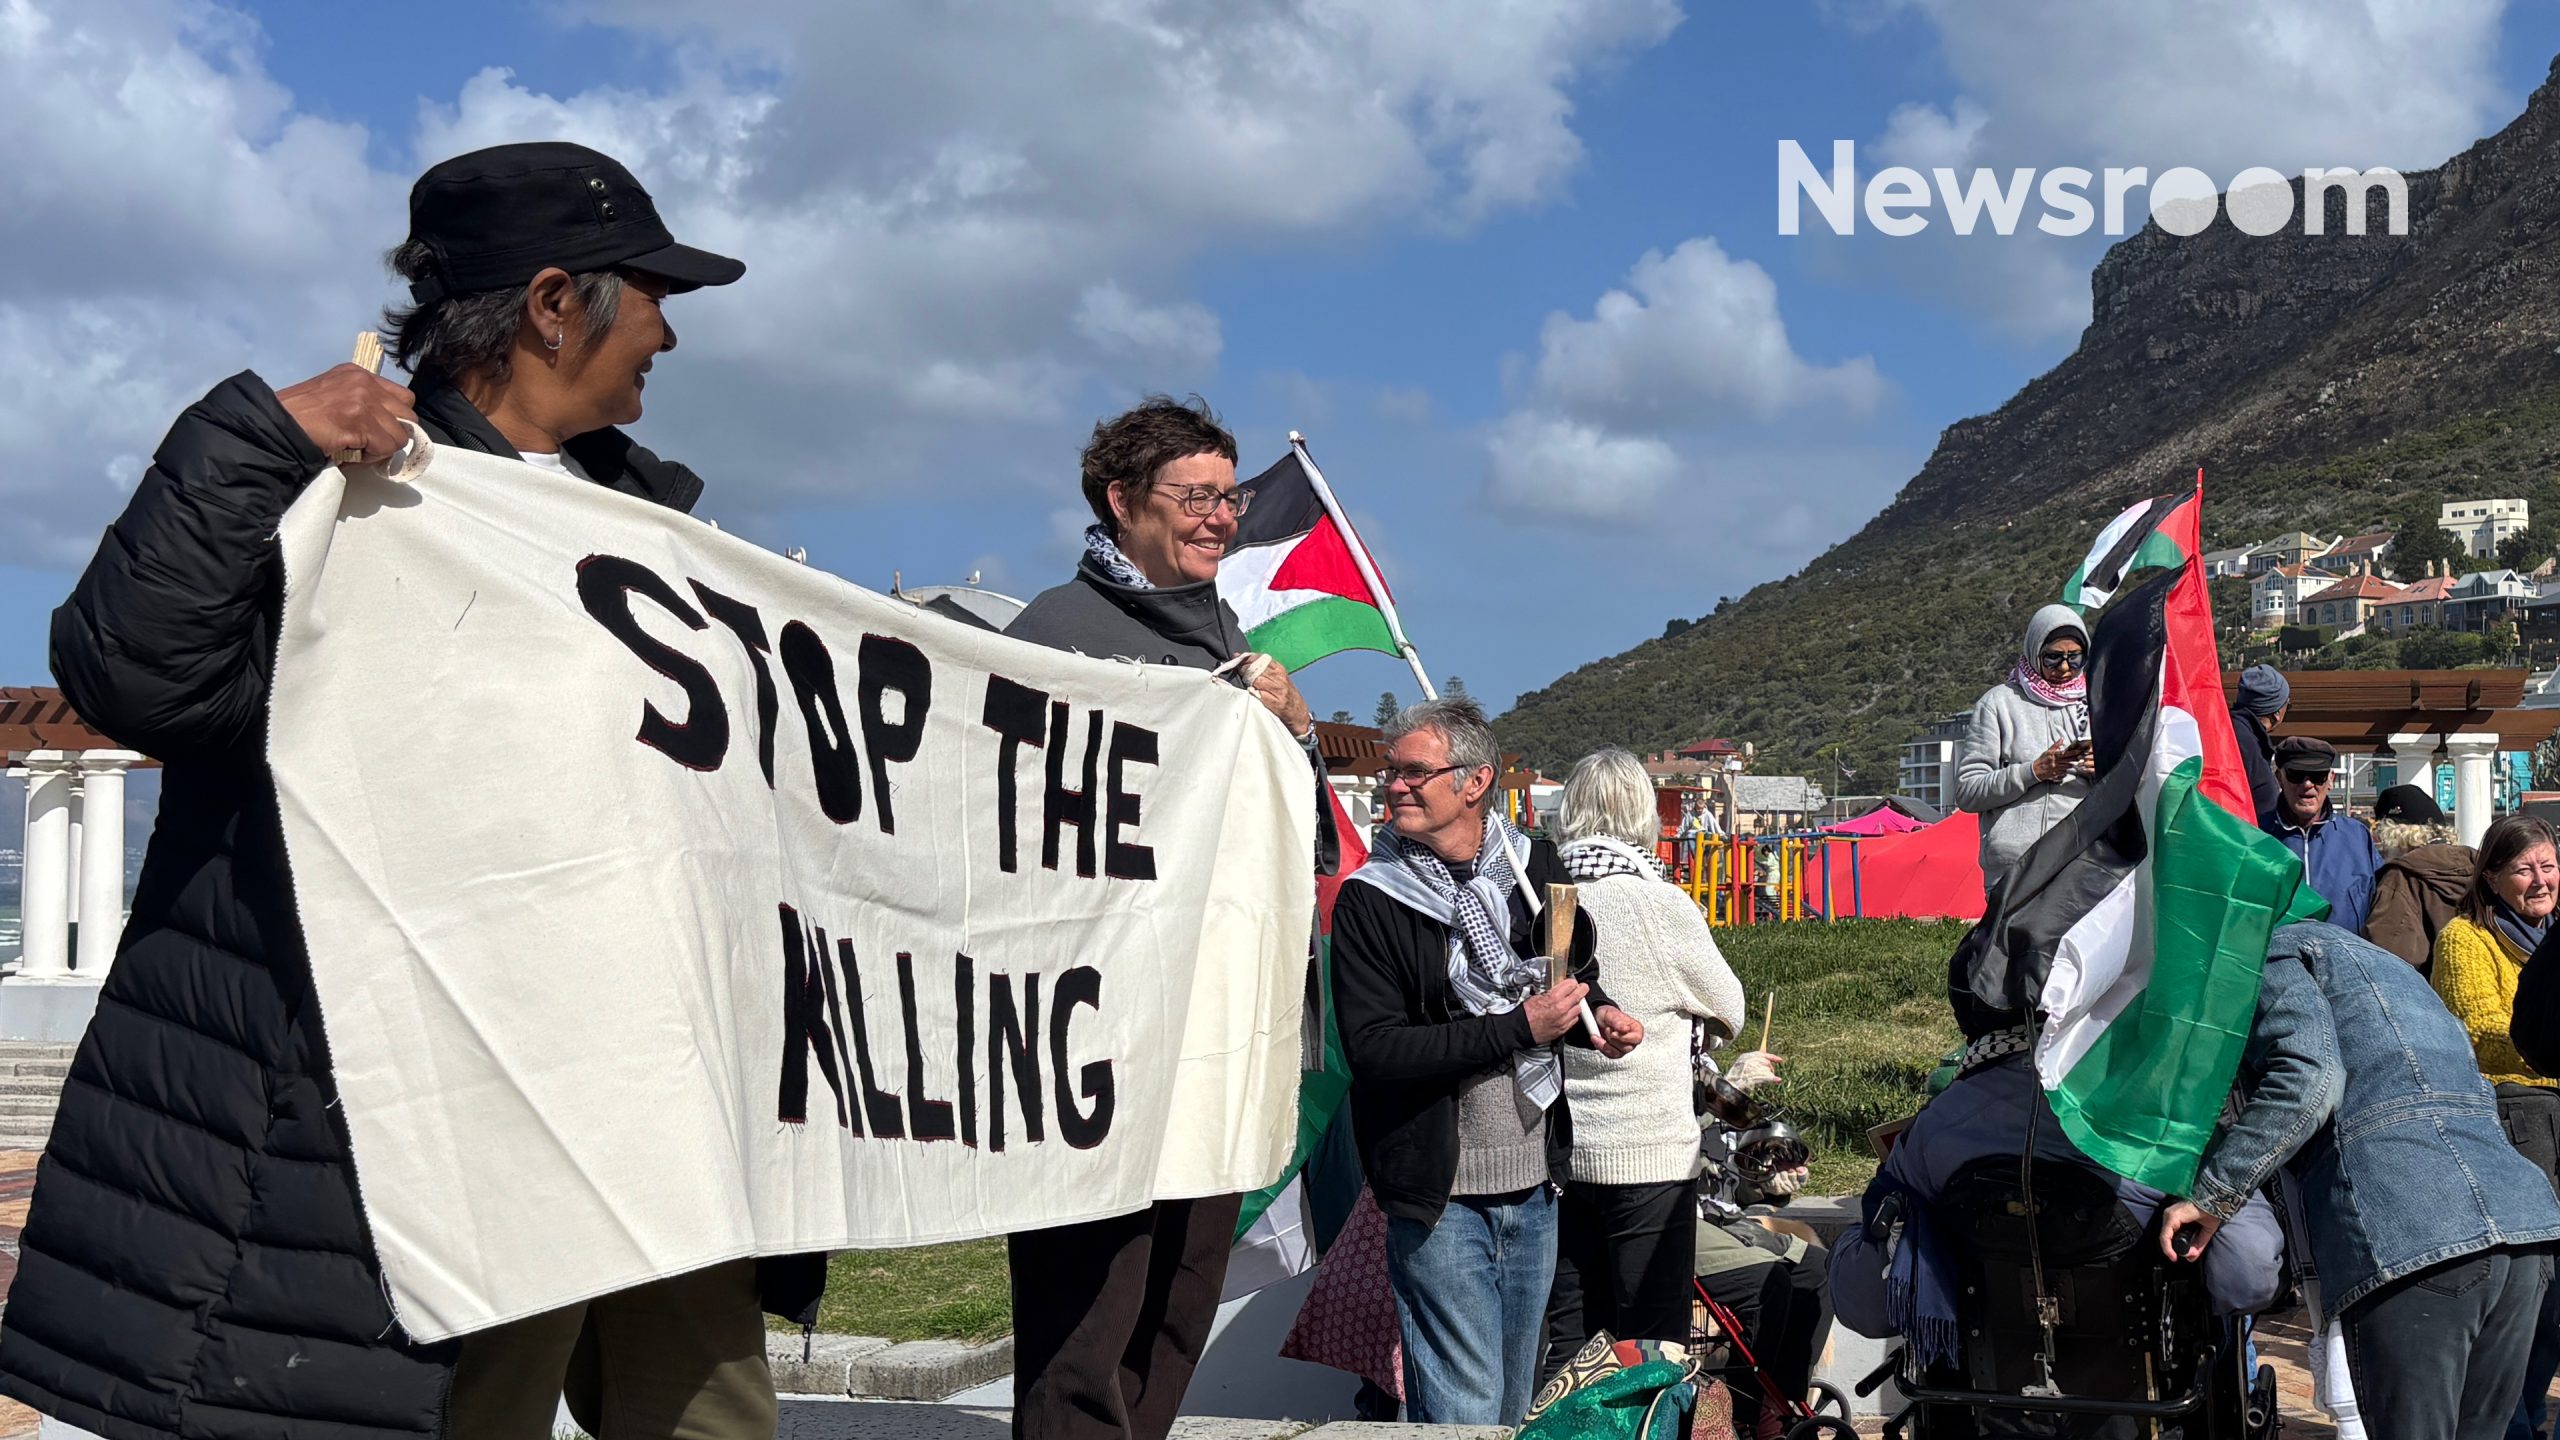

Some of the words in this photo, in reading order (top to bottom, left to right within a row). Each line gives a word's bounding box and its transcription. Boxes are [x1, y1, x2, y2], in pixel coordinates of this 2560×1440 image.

[575, 552, 932, 836] STOP
[982, 672, 1160, 881] THE
[778, 901, 1116, 1154] KILLING
